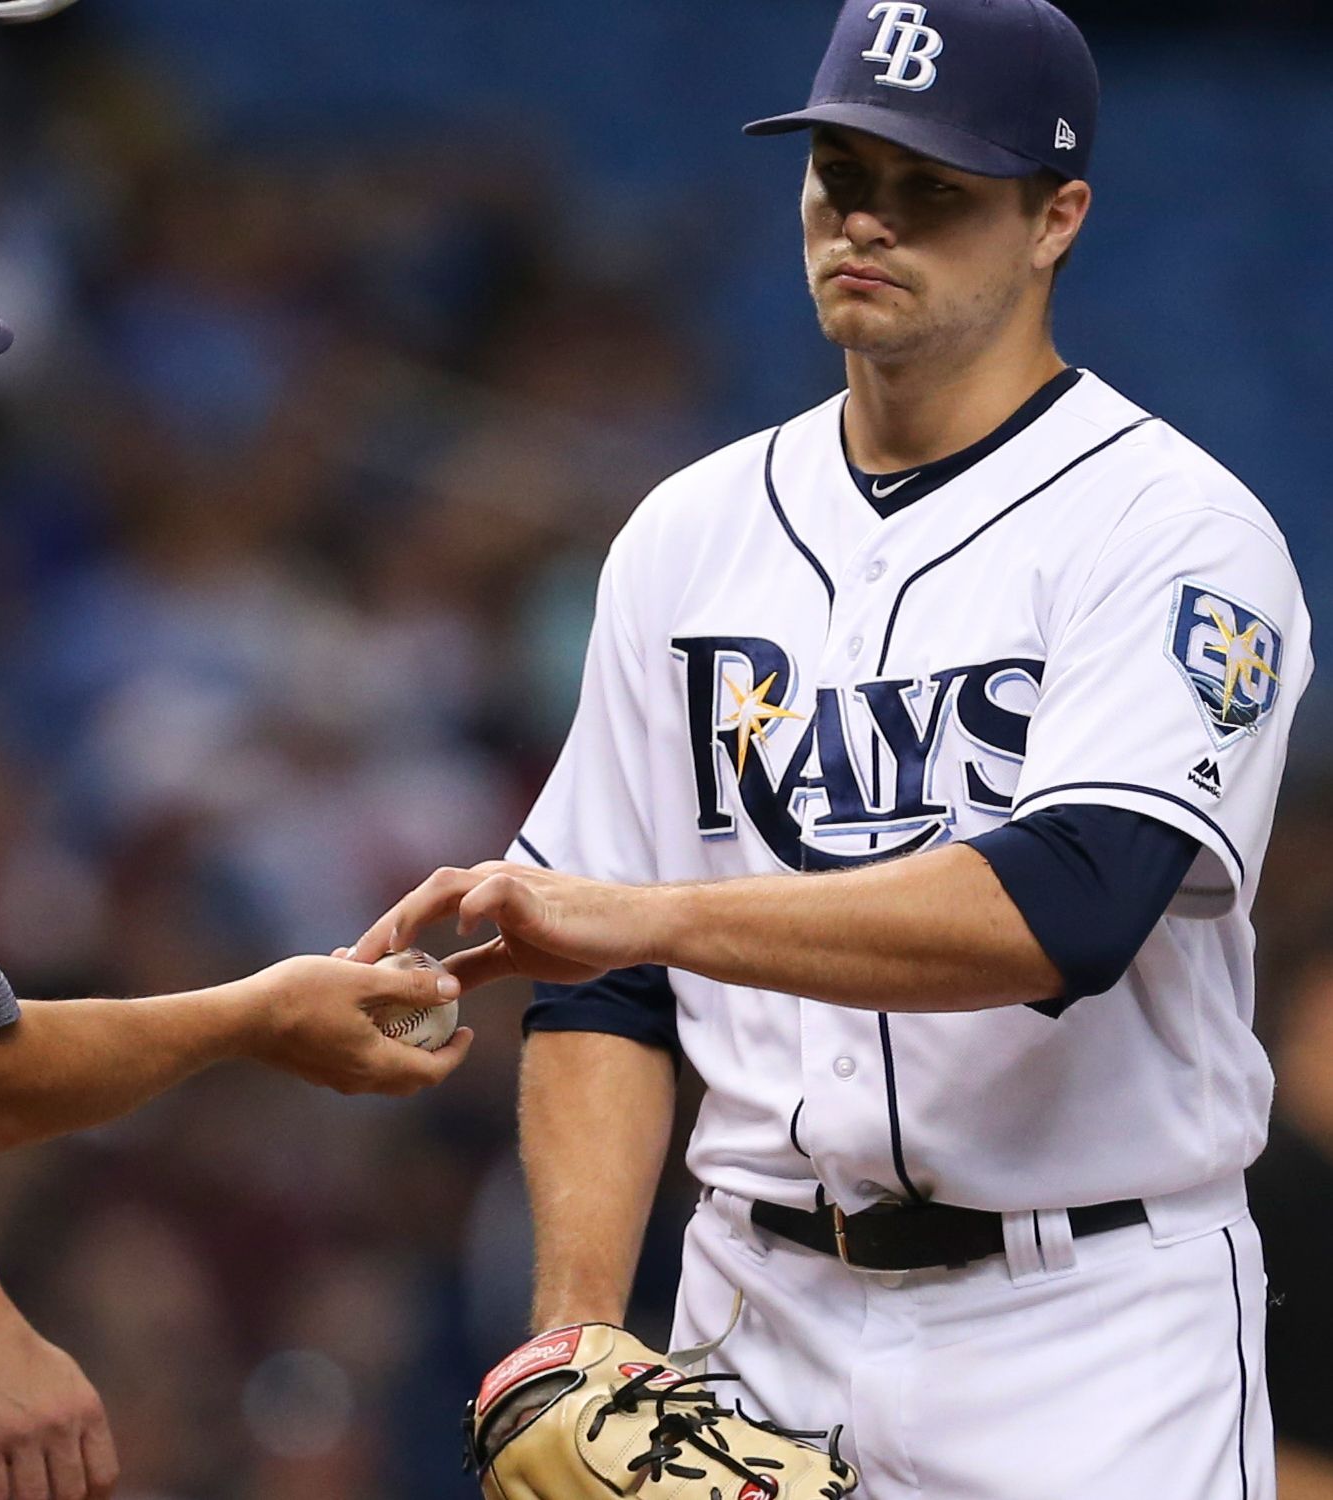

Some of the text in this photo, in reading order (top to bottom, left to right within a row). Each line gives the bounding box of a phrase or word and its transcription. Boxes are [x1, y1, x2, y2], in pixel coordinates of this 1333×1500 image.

[861, 2, 944, 91] TB
[1185, 593, 1275, 704] 20
[668, 633, 1046, 873] RAYS
